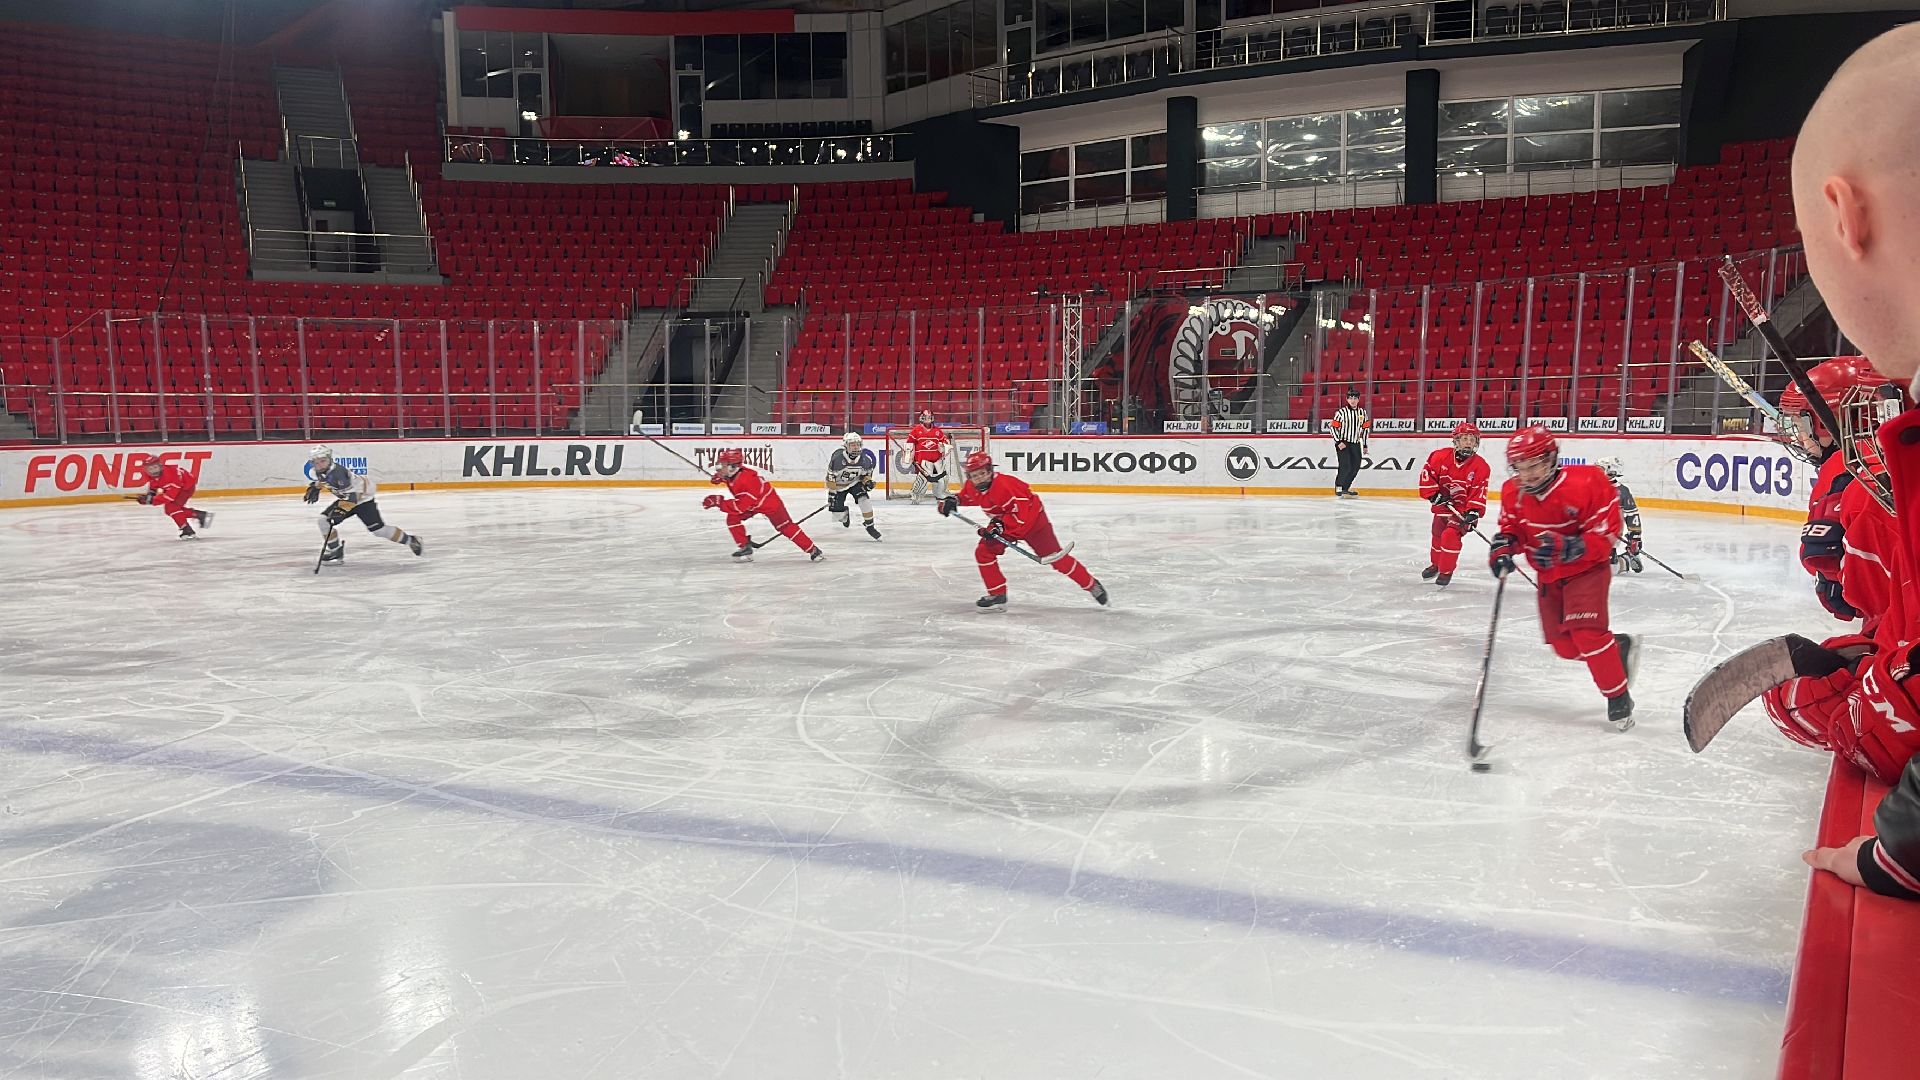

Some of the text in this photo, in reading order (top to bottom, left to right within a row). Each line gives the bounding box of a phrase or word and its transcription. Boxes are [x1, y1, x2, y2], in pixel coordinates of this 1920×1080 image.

[1166, 422, 1199, 431] KHL.RU
[1215, 422, 1249, 430] KHL.RU
[1270, 421, 1304, 430] KHL.RU
[1375, 420, 1412, 429] KHL.RU
[1479, 420, 1514, 429] KHL.RU
[1581, 419, 1616, 429] KHL.RU
[1628, 419, 1663, 429] KHL.RU
[462, 444, 624, 477] KHL.RU
[694, 444, 774, 474] ТУКИЙ
[1005, 451, 1197, 474] ТИНЬКОФФ
